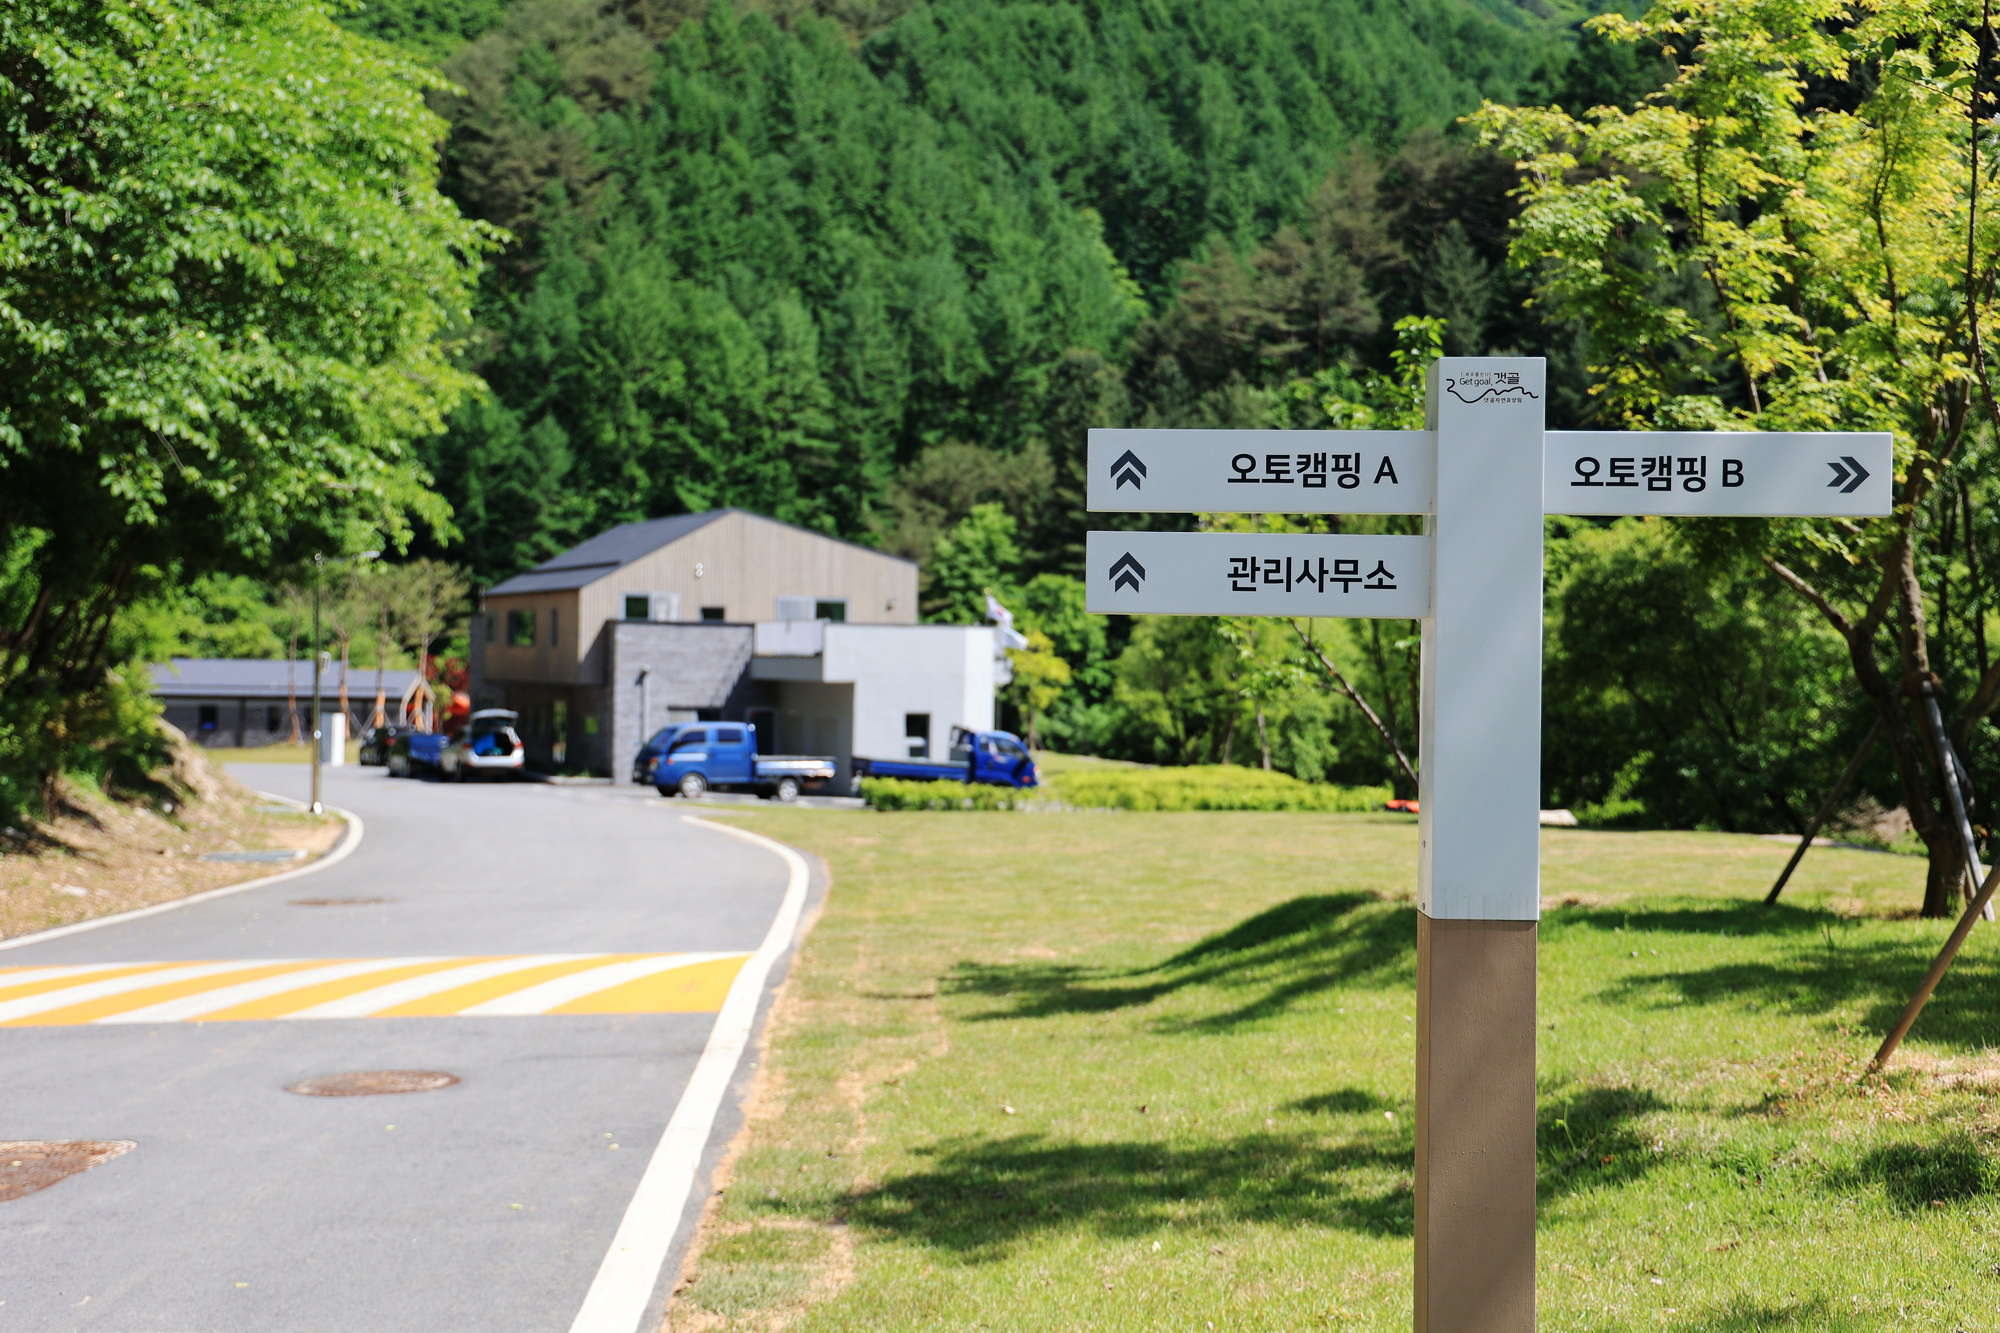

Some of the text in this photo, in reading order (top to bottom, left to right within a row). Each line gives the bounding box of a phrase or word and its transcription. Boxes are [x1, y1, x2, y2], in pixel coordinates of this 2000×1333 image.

[1459, 377, 1473, 386] Get
[1494, 372, 1520, 385] 갯골
[1227, 452, 1399, 489] 오토캠핑 A
[1570, 455, 1745, 493] 오토캠핑 B
[1227, 556, 1398, 594] 관리사무소
